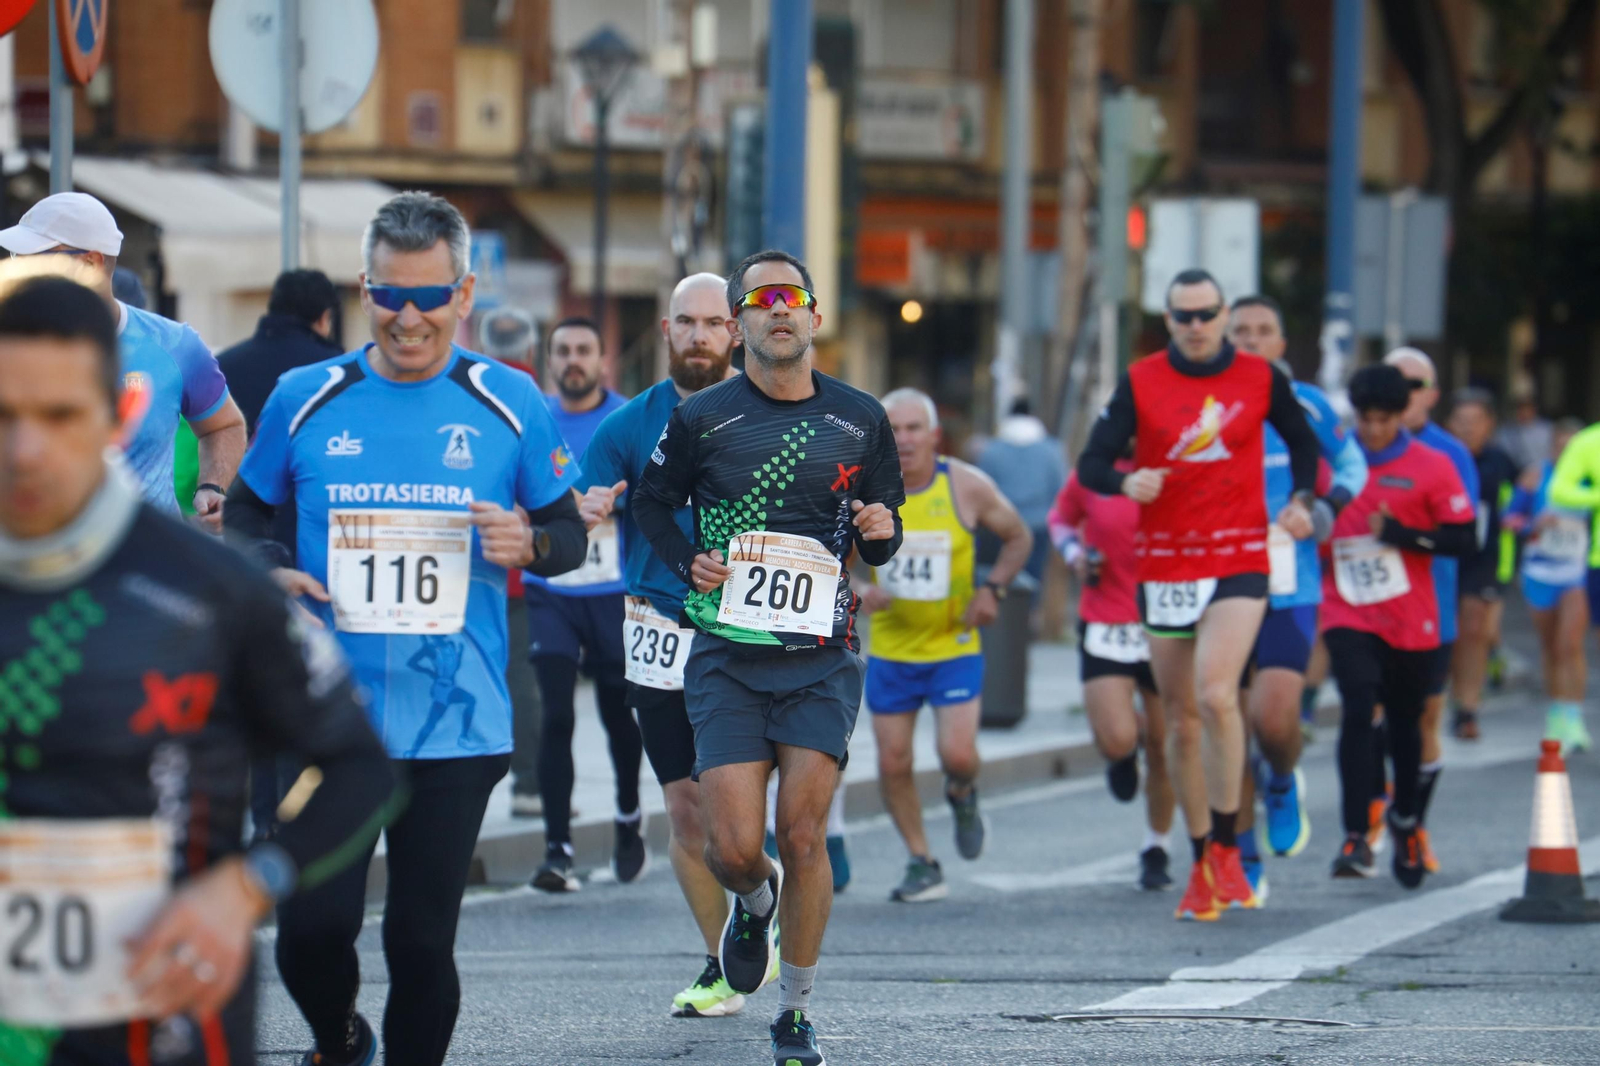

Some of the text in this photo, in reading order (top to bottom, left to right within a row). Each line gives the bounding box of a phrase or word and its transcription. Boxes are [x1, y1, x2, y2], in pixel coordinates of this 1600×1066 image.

[833, 417, 865, 438] IMDECO
[325, 483, 474, 505] TROTASIERRA
[334, 514, 374, 550] XLI
[780, 537, 802, 548] CARRERA
[733, 535, 767, 562] XLI
[765, 556, 791, 566] MEMORIAL
[811, 554, 836, 563] TRINITARIOS
[359, 554, 439, 605] 116
[887, 557, 932, 583] 244
[744, 565, 813, 614] 260
[631, 625, 680, 669] 239
[6, 893, 95, 975] 20
